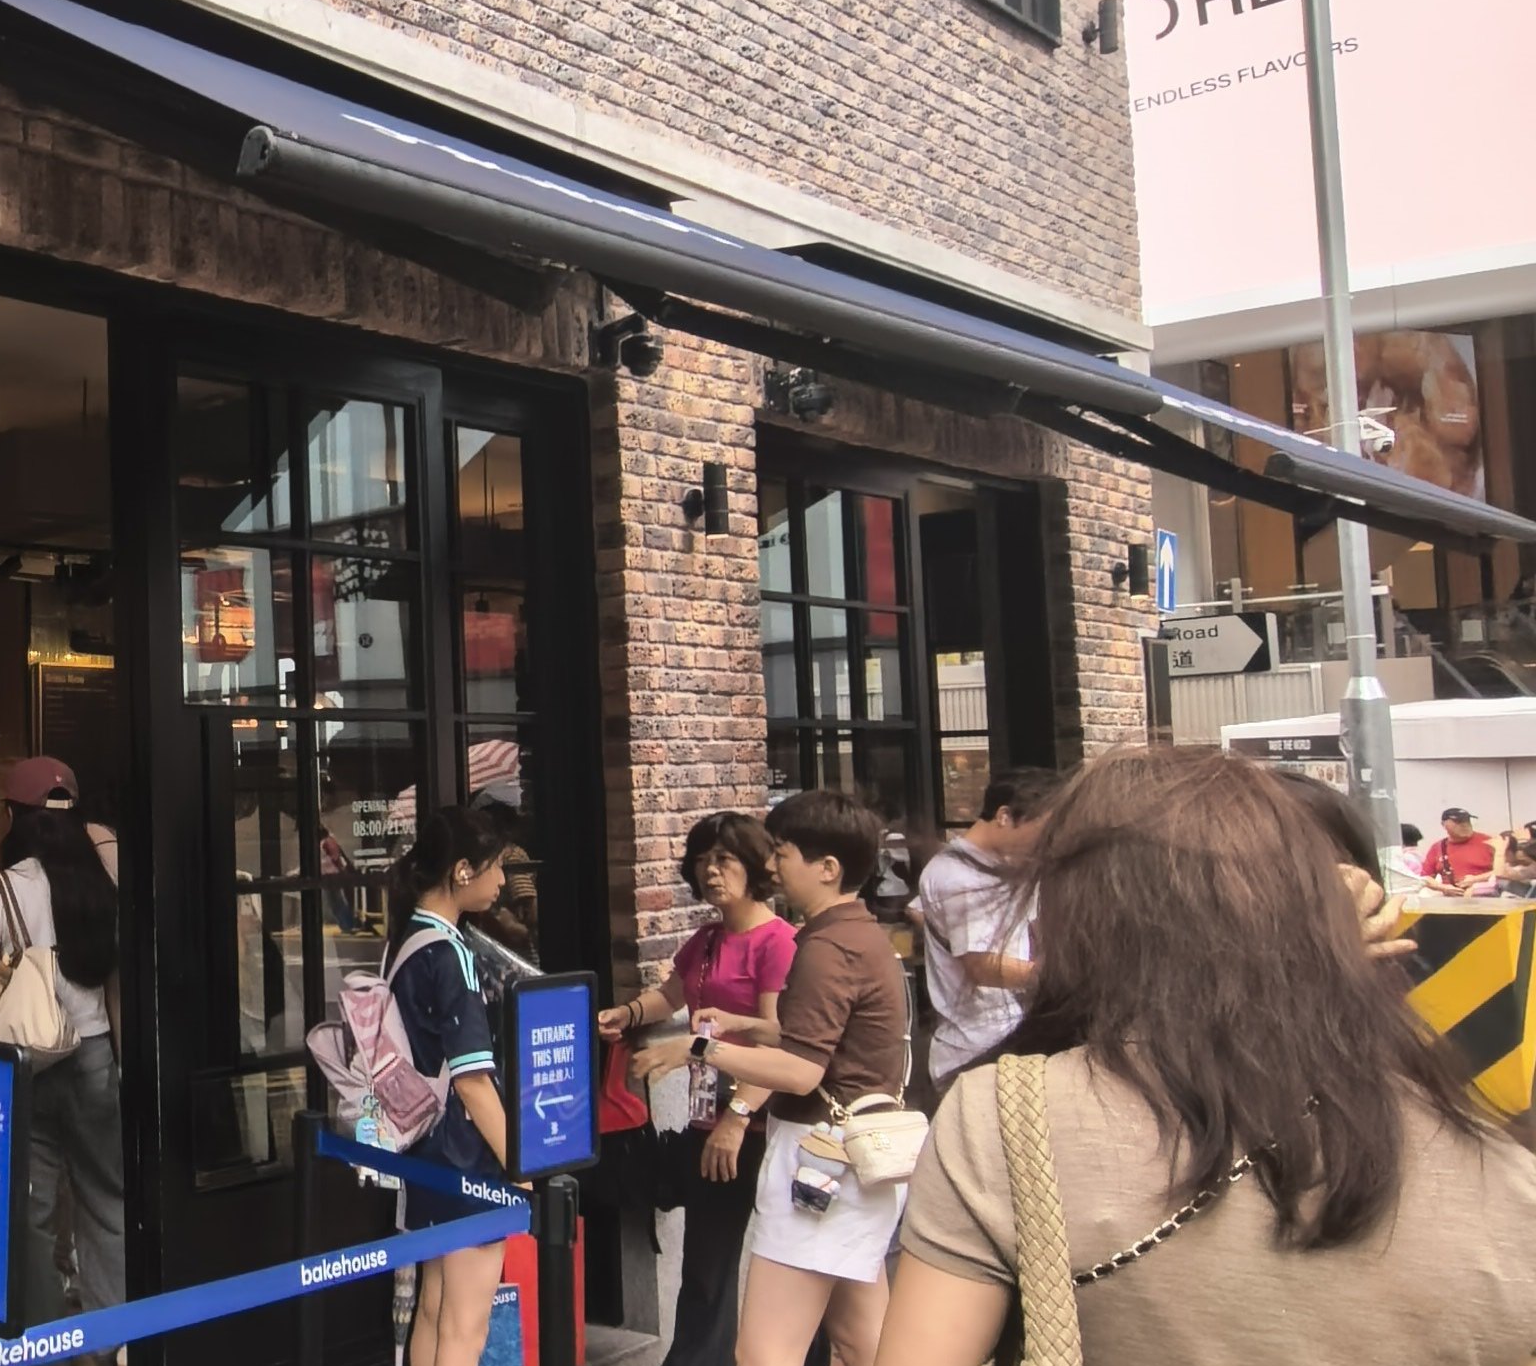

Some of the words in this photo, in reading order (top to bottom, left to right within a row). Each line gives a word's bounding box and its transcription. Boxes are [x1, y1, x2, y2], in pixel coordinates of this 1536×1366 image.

[1133, 73, 1232, 113] ENDLESS
[1237, 37, 1359, 83] FLAVORS
[1172, 649, 1195, 669] 道
[531, 1023, 575, 1046] ENTRANCE
[532, 1049, 552, 1068] THIS
[553, 1045, 574, 1066] WAY!
[461, 1175, 527, 1207] bakeho
[301, 1249, 388, 1286] bakehouse
